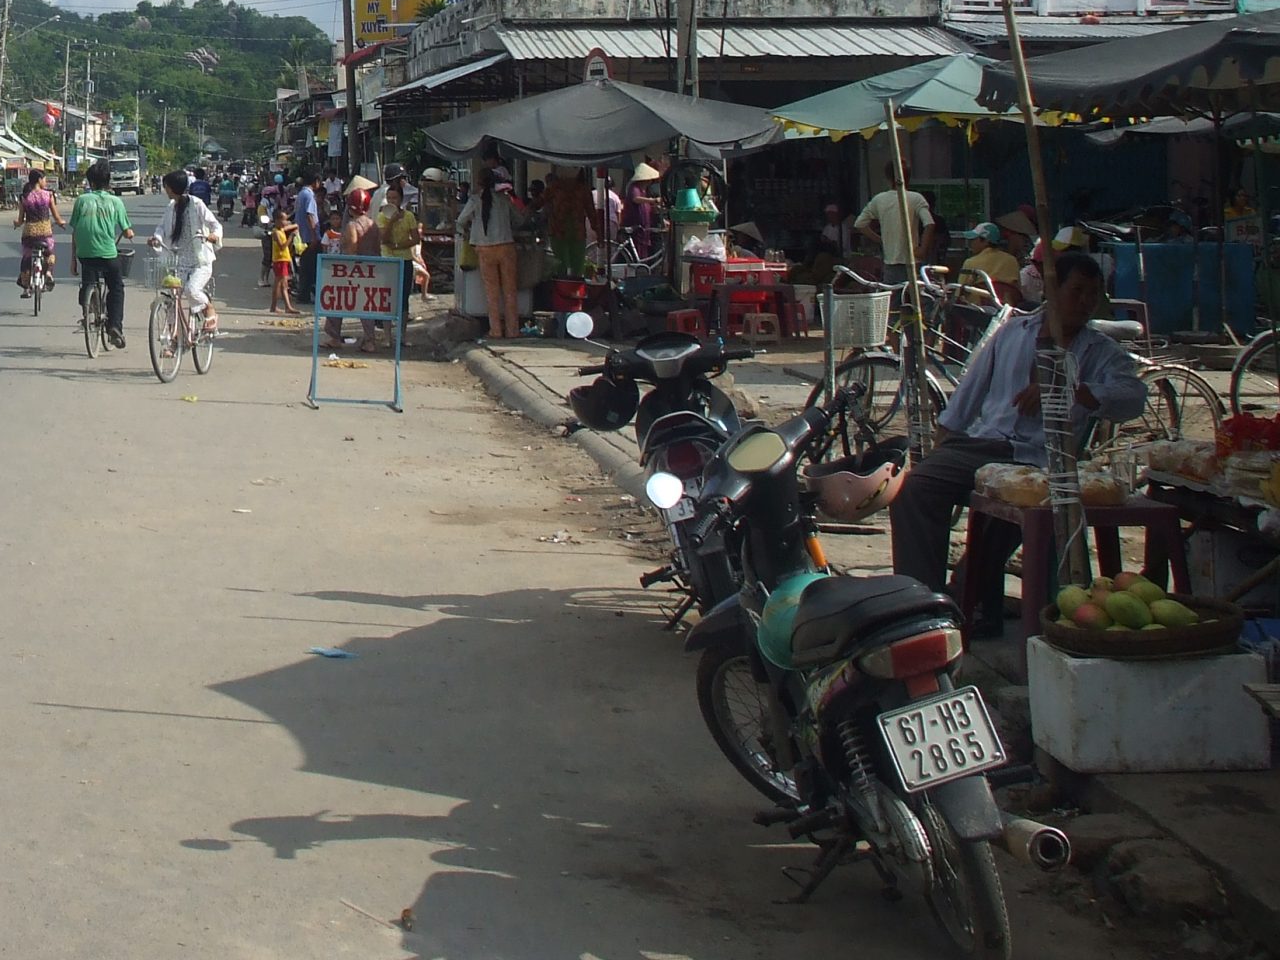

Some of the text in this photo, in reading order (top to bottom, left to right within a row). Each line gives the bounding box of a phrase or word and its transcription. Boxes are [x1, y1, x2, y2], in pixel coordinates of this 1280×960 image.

[363, 287, 392, 312] XE
[897, 699, 972, 746] 67-H3
[910, 730, 985, 778] 2865
